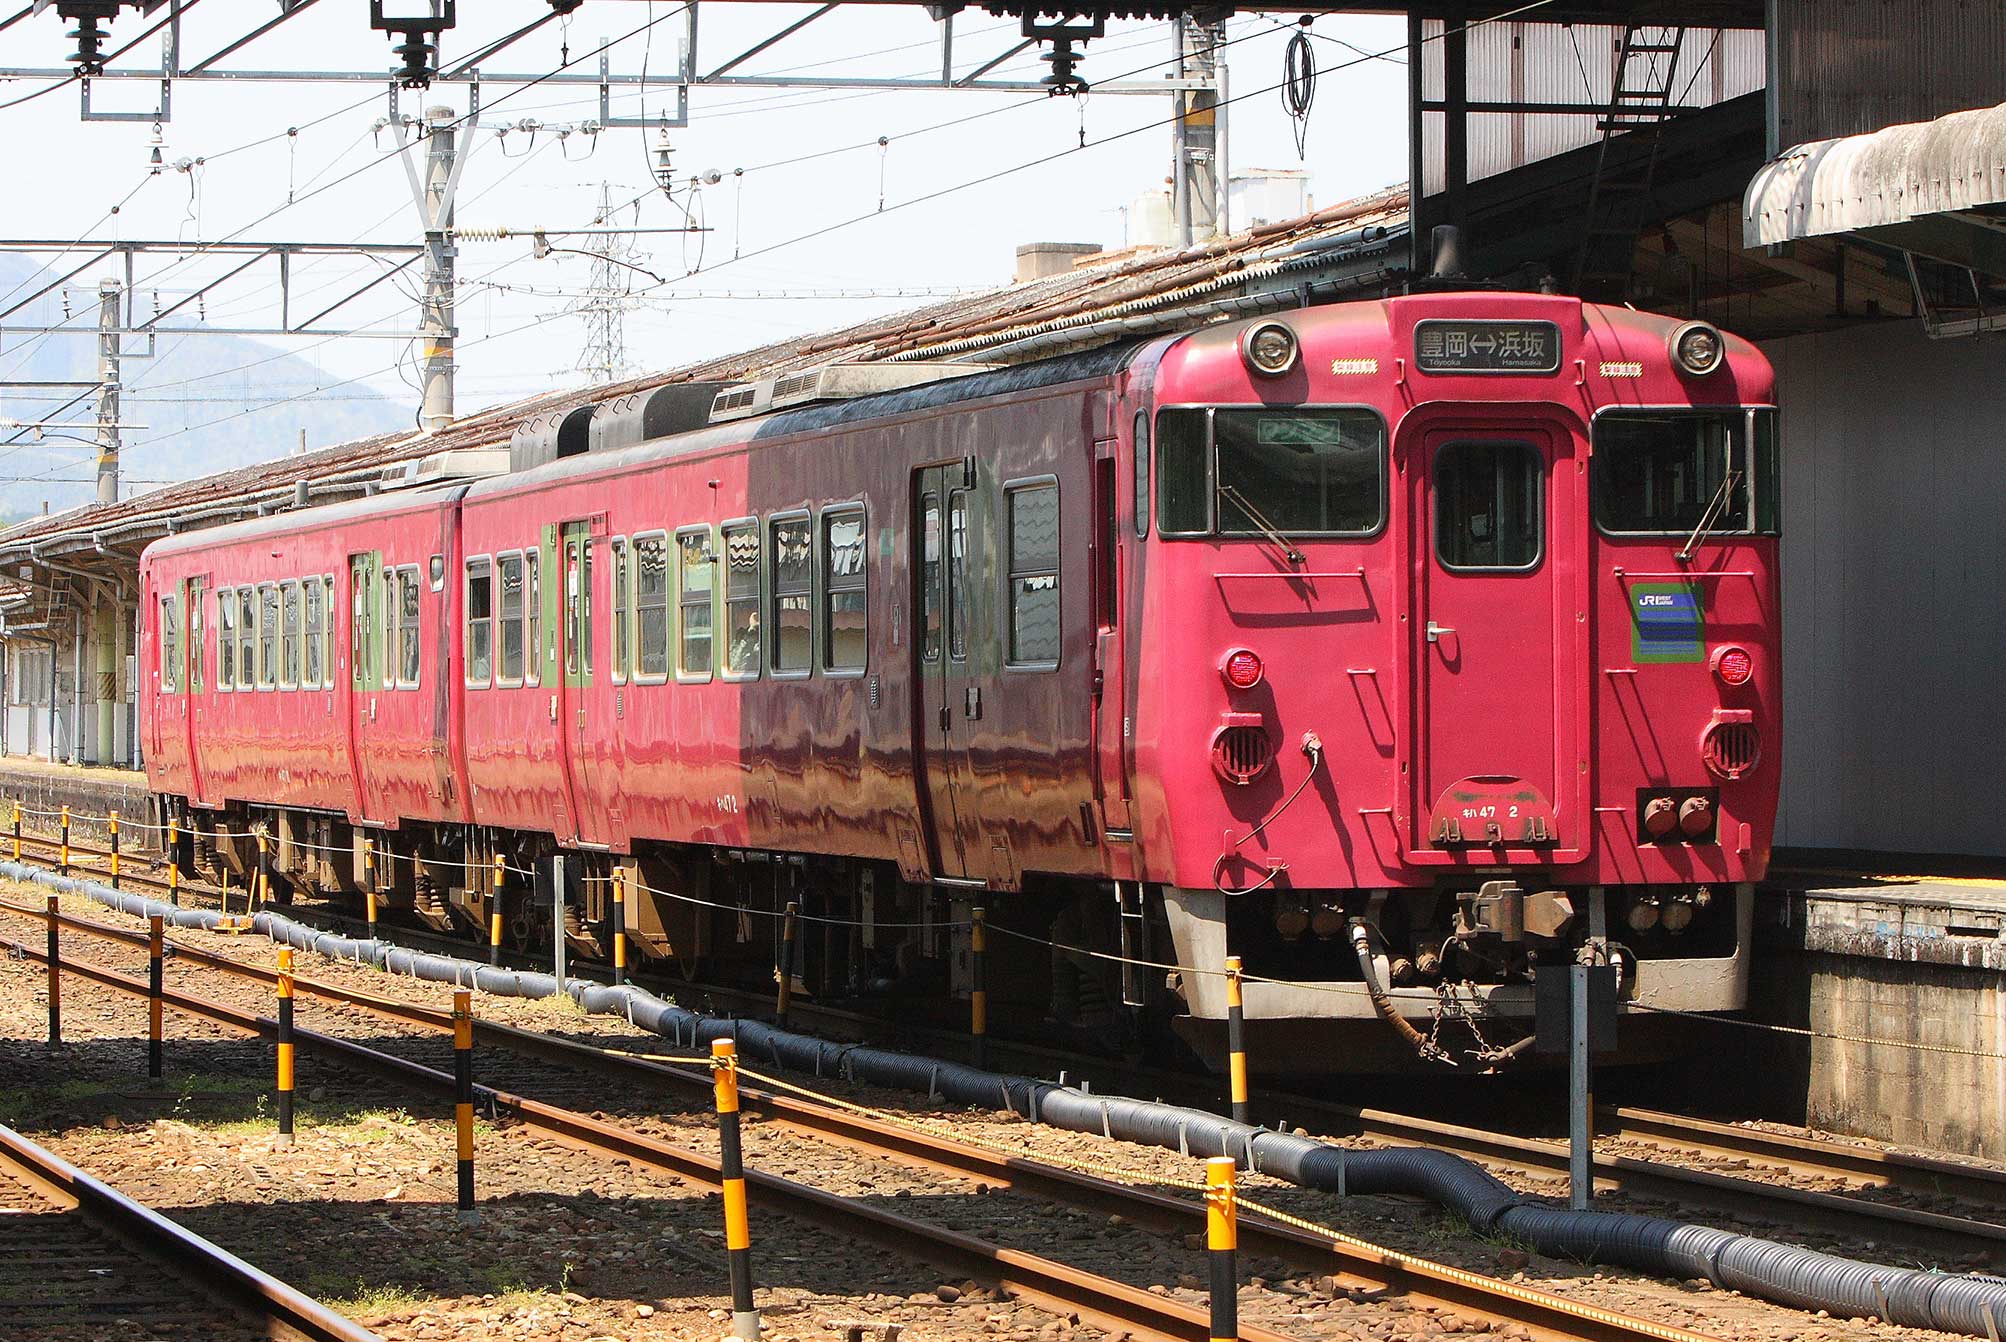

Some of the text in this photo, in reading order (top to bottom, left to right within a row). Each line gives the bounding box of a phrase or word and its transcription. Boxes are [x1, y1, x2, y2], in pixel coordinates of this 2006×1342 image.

[1421, 331, 1545, 358] 豊岡 浜坂
[1639, 595, 1654, 606] JR
[1509, 805, 1519, 818] 2
